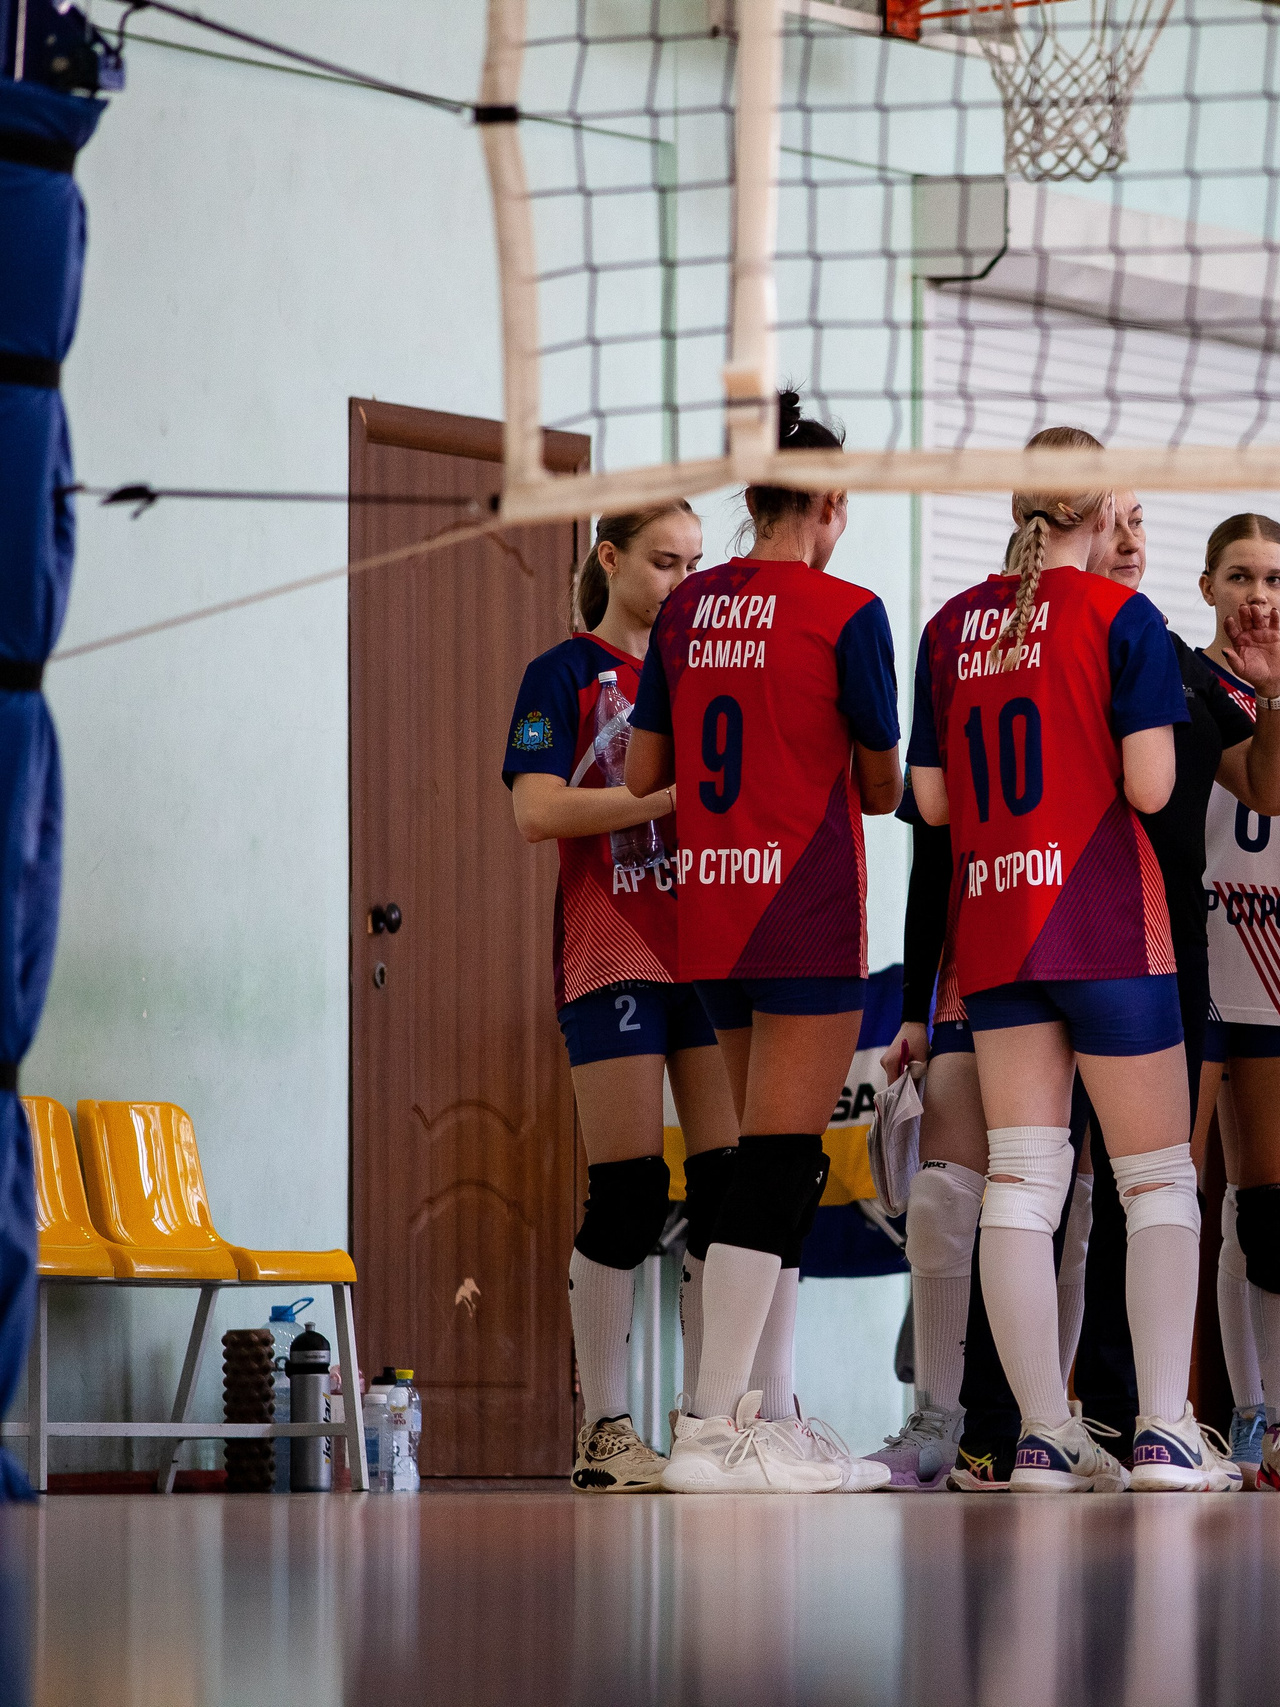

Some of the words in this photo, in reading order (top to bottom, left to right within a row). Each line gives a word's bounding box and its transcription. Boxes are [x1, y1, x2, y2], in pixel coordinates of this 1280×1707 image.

[692, 594, 776, 629] ИСКРА
[688, 640, 766, 668] САМАРА
[699, 695, 743, 814] 9
[963, 696, 1044, 823] 10
[653, 856, 677, 892] С
[699, 841, 782, 885] СТРОЙ
[968, 858, 988, 899] АР
[994, 842, 1062, 892] СТРОЙ
[1204, 889, 1220, 911] Р
[614, 994, 641, 1032] 2
